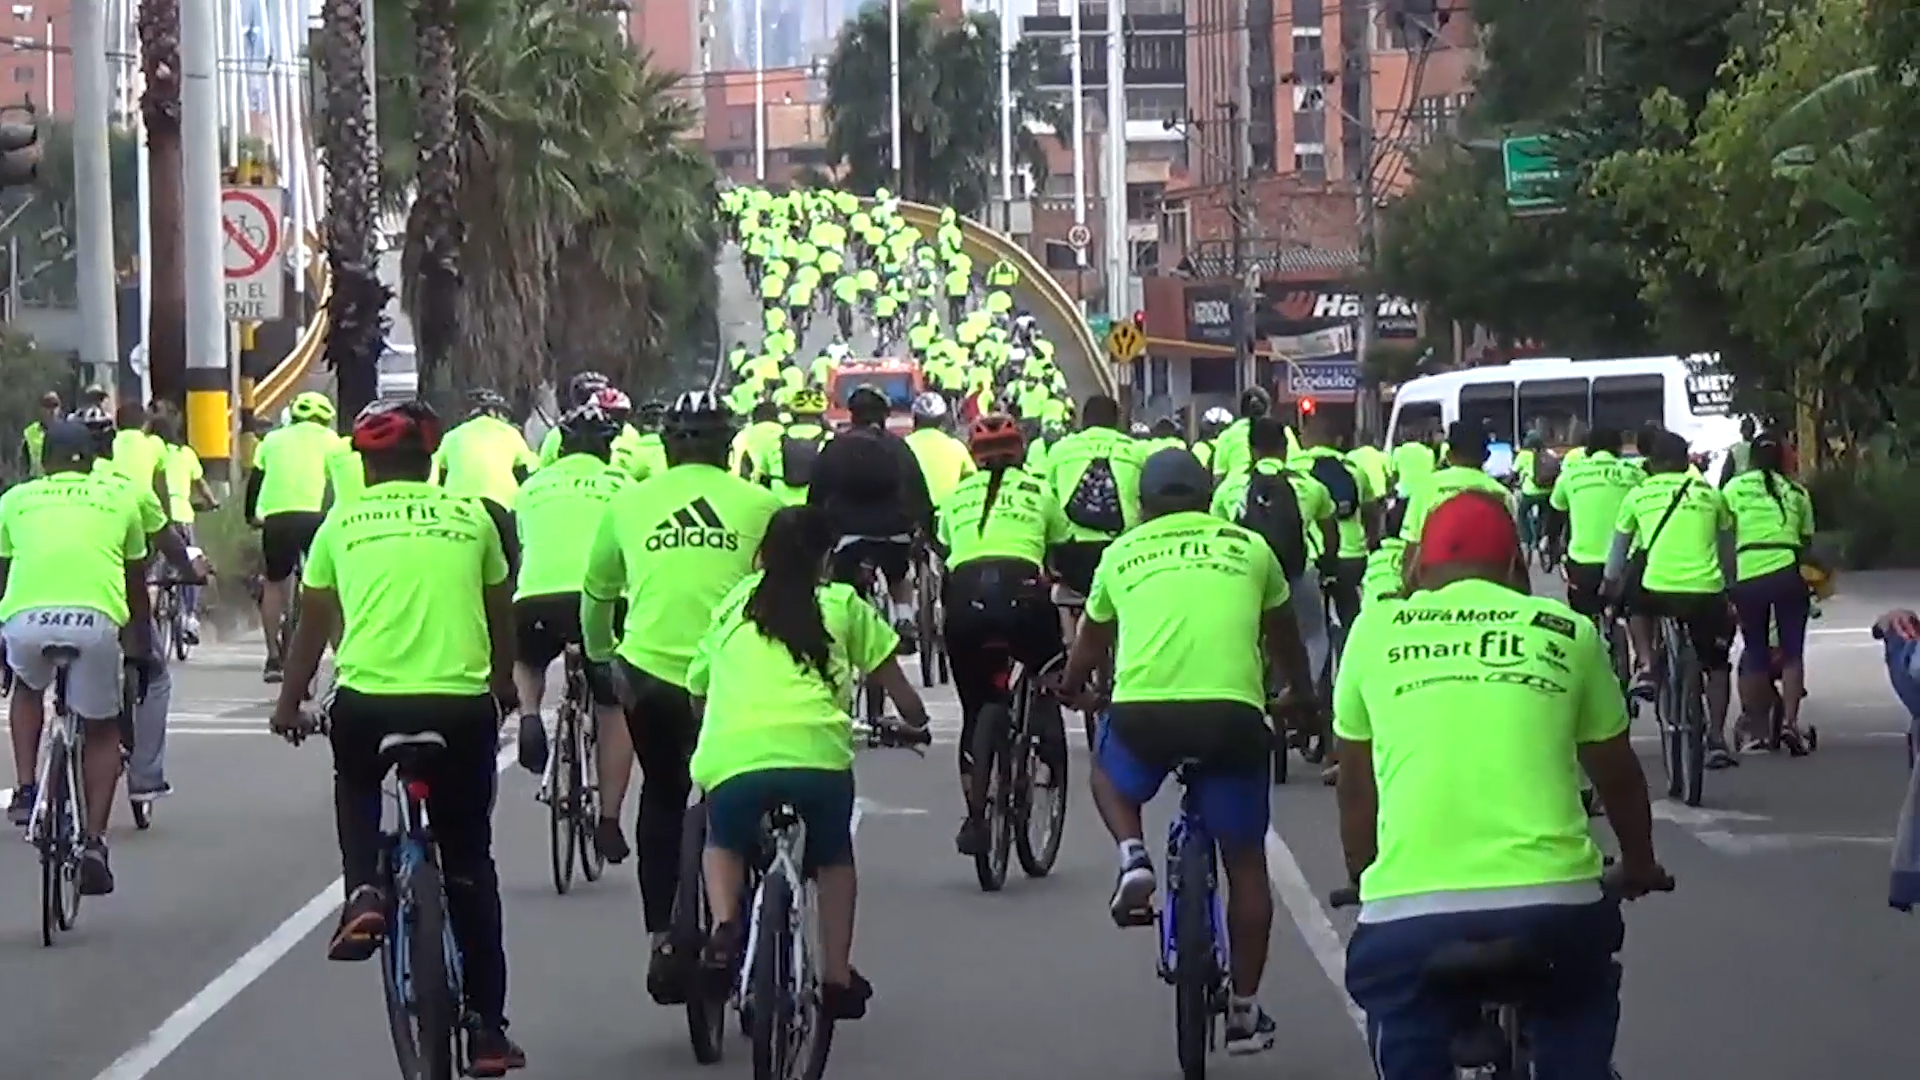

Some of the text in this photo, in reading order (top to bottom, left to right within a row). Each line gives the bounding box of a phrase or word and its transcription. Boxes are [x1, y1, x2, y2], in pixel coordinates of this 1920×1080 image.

[248, 283, 266, 298] EL
[225, 301, 264, 317] ENTE
[645, 527, 739, 552] adidas
[1456, 609, 1520, 622] Motor
[1388, 630, 1525, 664] smart fit
